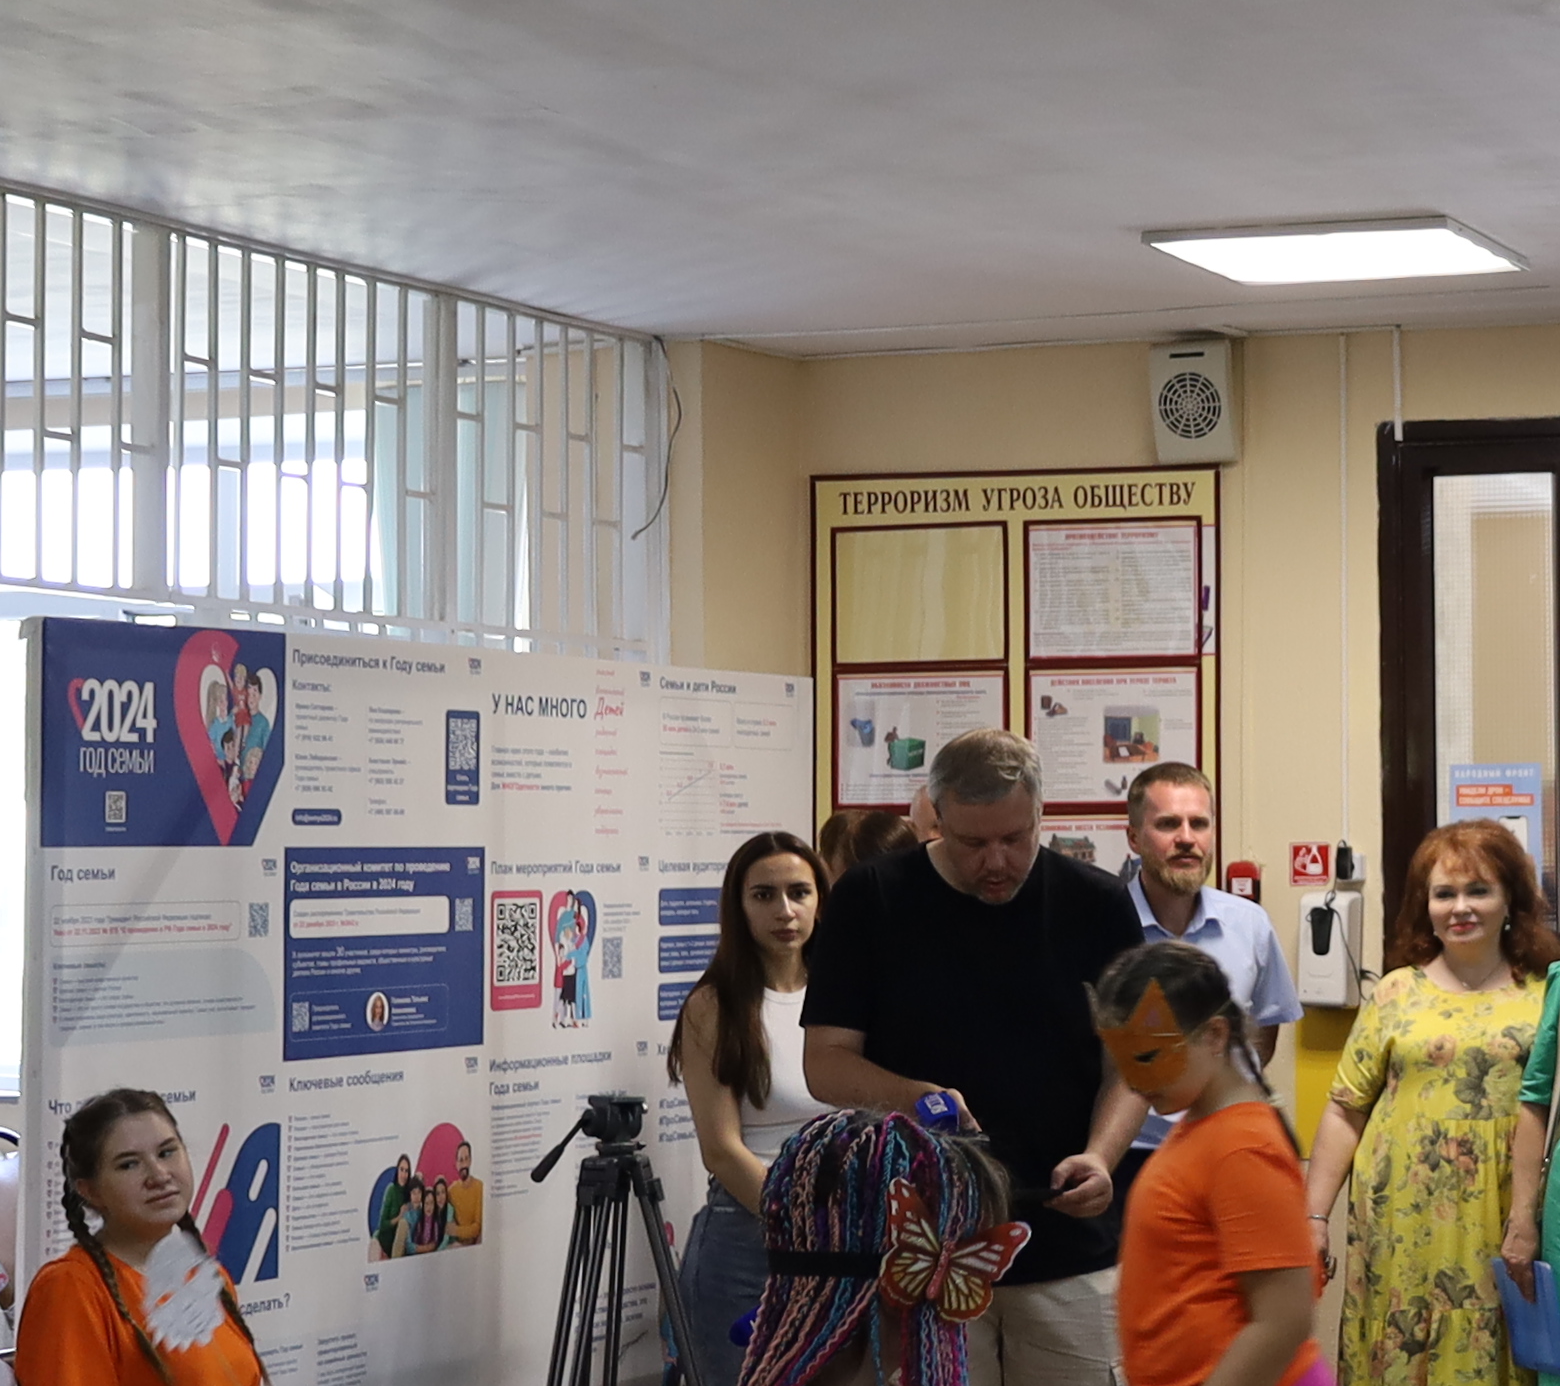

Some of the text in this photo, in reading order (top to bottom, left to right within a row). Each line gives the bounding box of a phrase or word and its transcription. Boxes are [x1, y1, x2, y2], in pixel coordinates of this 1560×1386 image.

[839, 482, 1196, 515] ТЕРРОРИЗМ УГРОЗА ОБЩЕСТВУ
[293, 649, 379, 669] Присоединиться
[390, 656, 414, 674] Году
[416, 661, 445, 673] семьи
[81, 678, 158, 743] 2024
[492, 693, 587, 719] У НАС МНОГО
[79, 747, 106, 778] ГОД
[50, 865, 115, 883] Год семьи
[490, 860, 621, 877] План мероприятий Года семьи
[289, 1070, 404, 1093] Ключевые сообщения
[48, 1099, 71, 1114] Что
